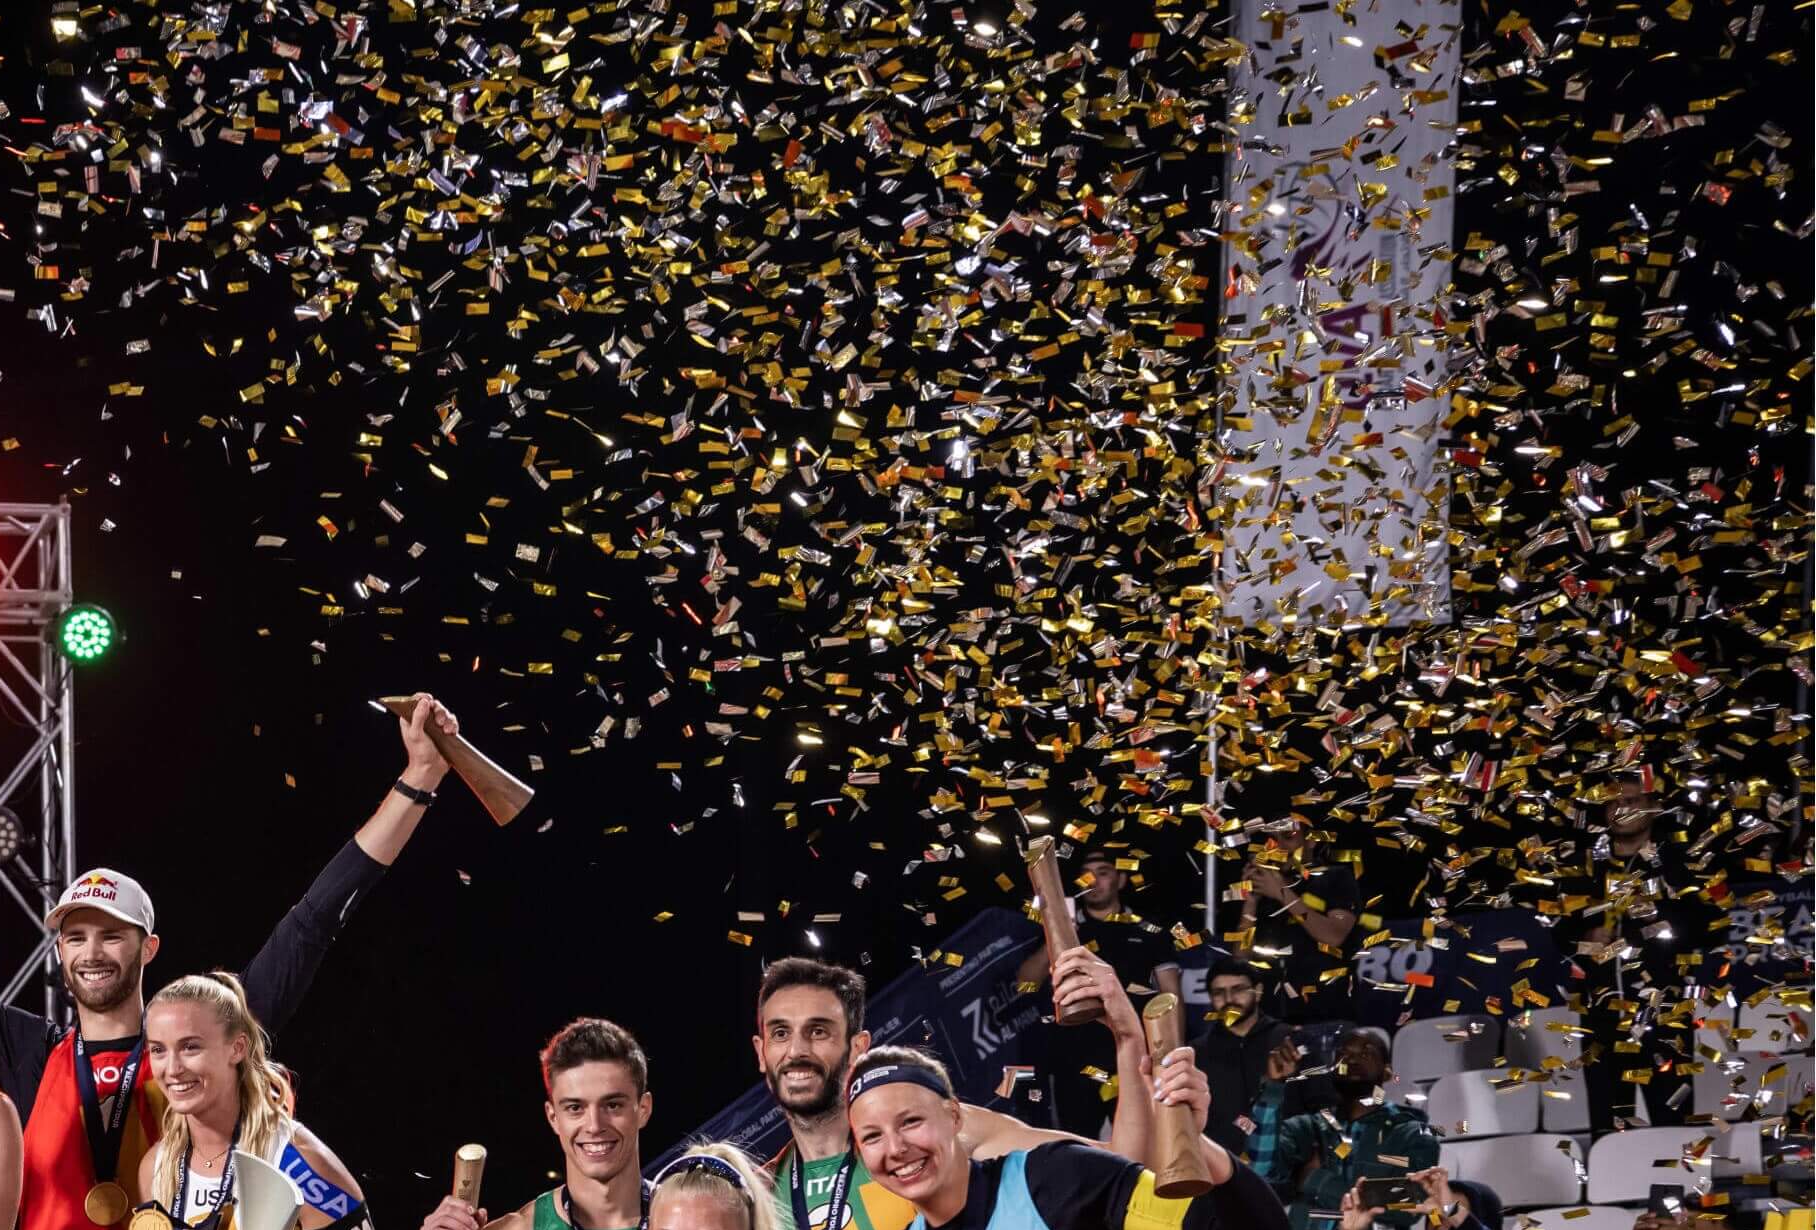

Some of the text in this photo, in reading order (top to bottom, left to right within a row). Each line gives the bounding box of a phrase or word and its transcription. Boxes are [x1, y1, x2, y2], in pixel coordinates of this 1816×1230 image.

[71, 887, 117, 902] Red Bull
[284, 1156, 349, 1220] USA
[195, 1189, 222, 1207] US
